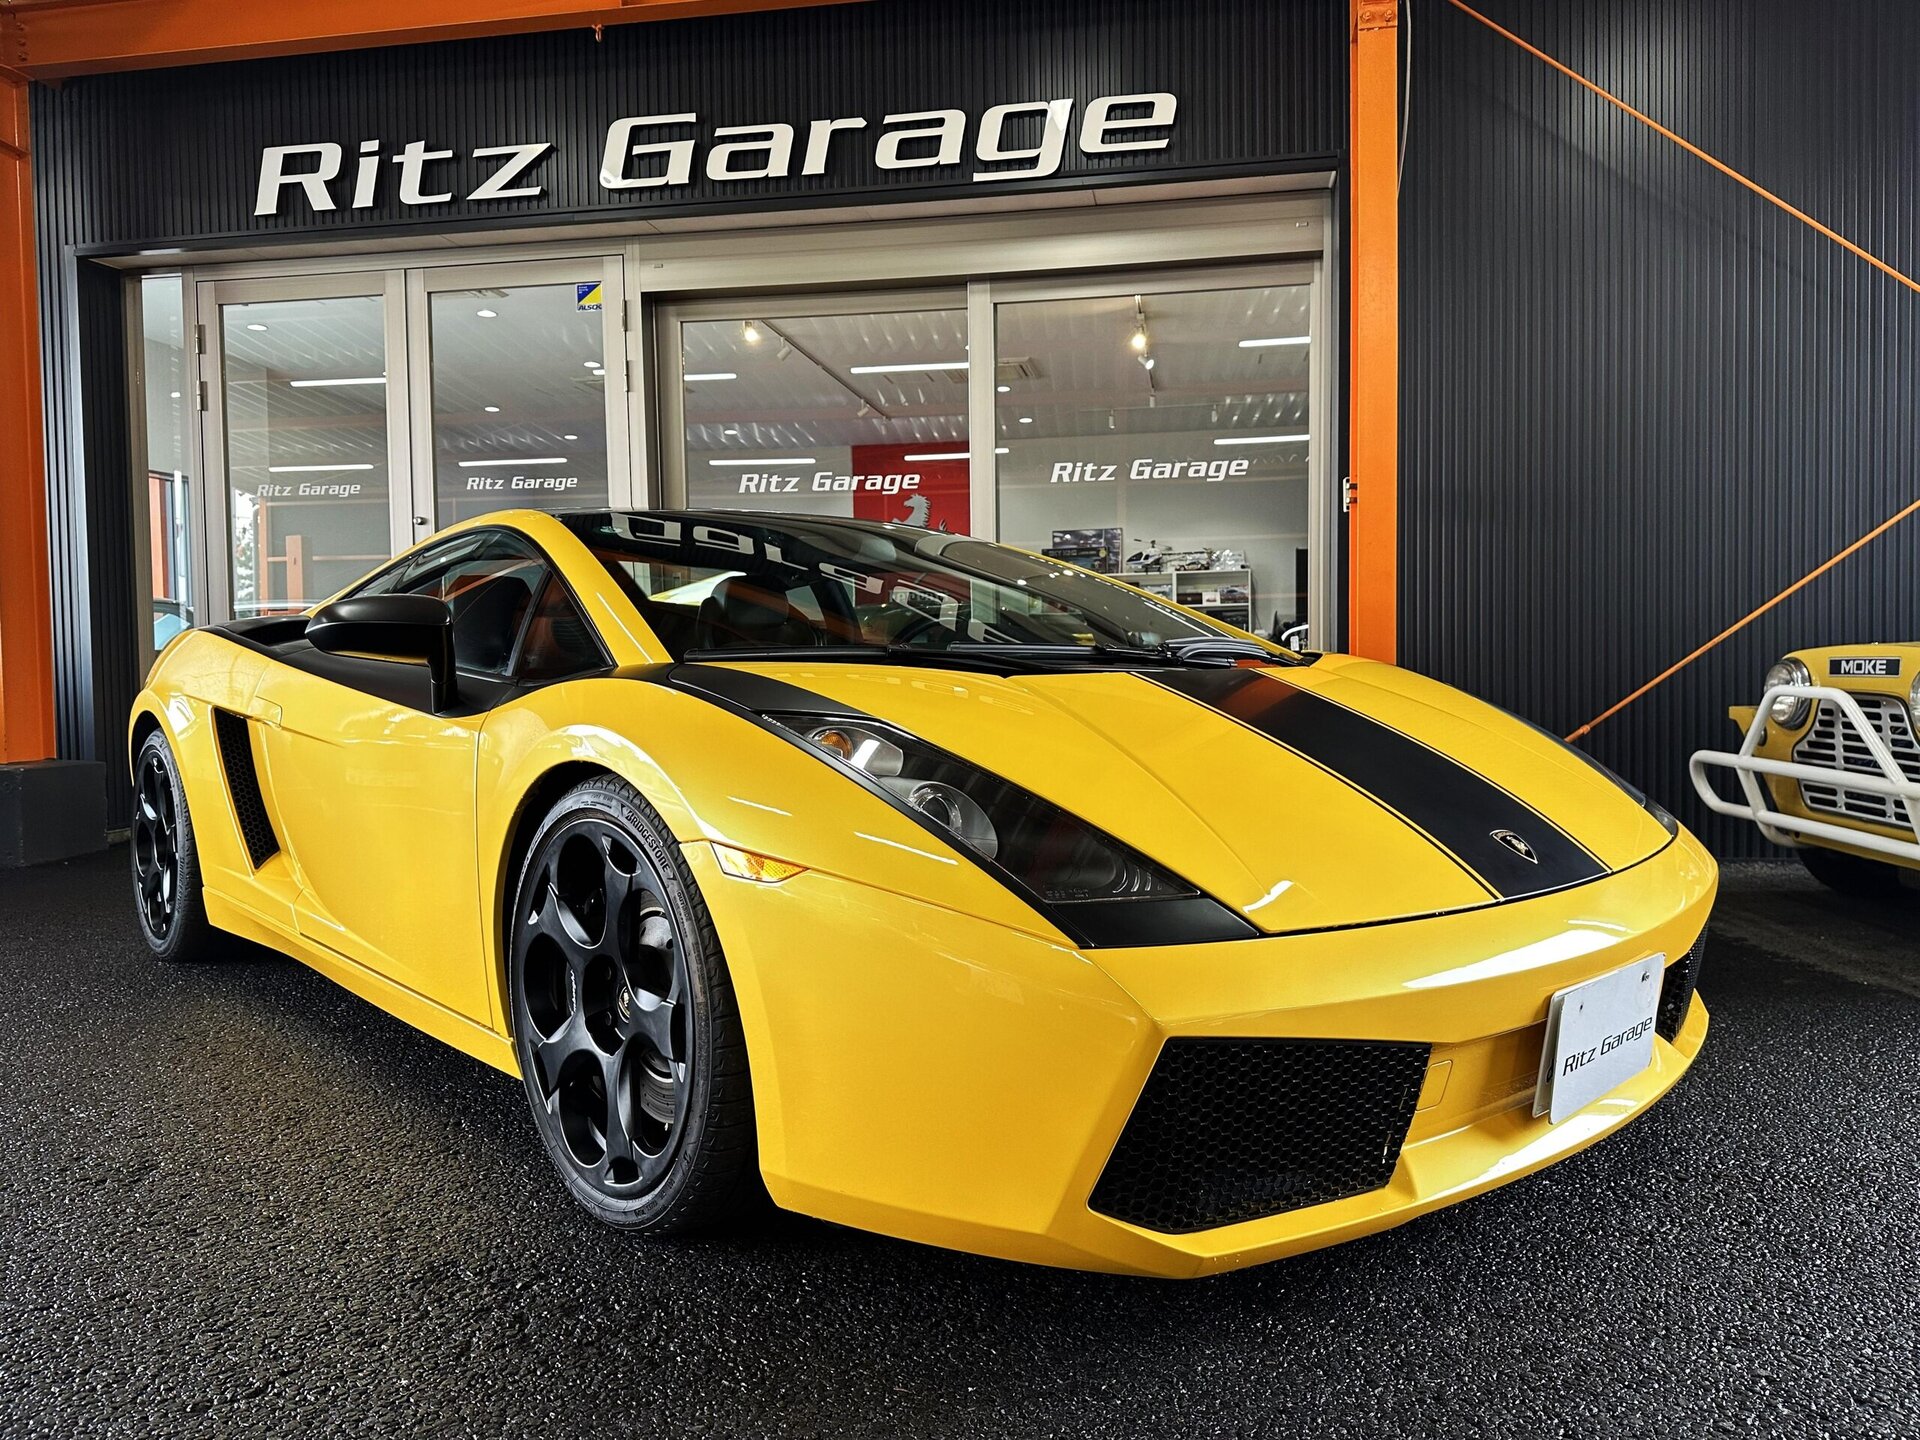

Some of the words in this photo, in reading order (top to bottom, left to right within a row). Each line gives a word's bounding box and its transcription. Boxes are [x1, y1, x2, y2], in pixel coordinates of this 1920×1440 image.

[253, 139, 551, 216] Ritz
[600, 92, 1177, 183] Garage
[1051, 462, 1117, 483] Ritz
[1130, 458, 1249, 482] Garage
[256, 484, 292, 497] Ritz
[298, 482, 361, 497] Garage
[466, 477, 504, 491] Ritz
[511, 475, 578, 492] Garage
[738, 473, 800, 494] Ritz
[811, 471, 920, 495] Garage
[1840, 659, 1887, 675] MOKE
[624, 810, 671, 873] BRIDGESTONE
[1562, 1046, 1598, 1077] Ritz
[1600, 1016, 1653, 1056] Garage
